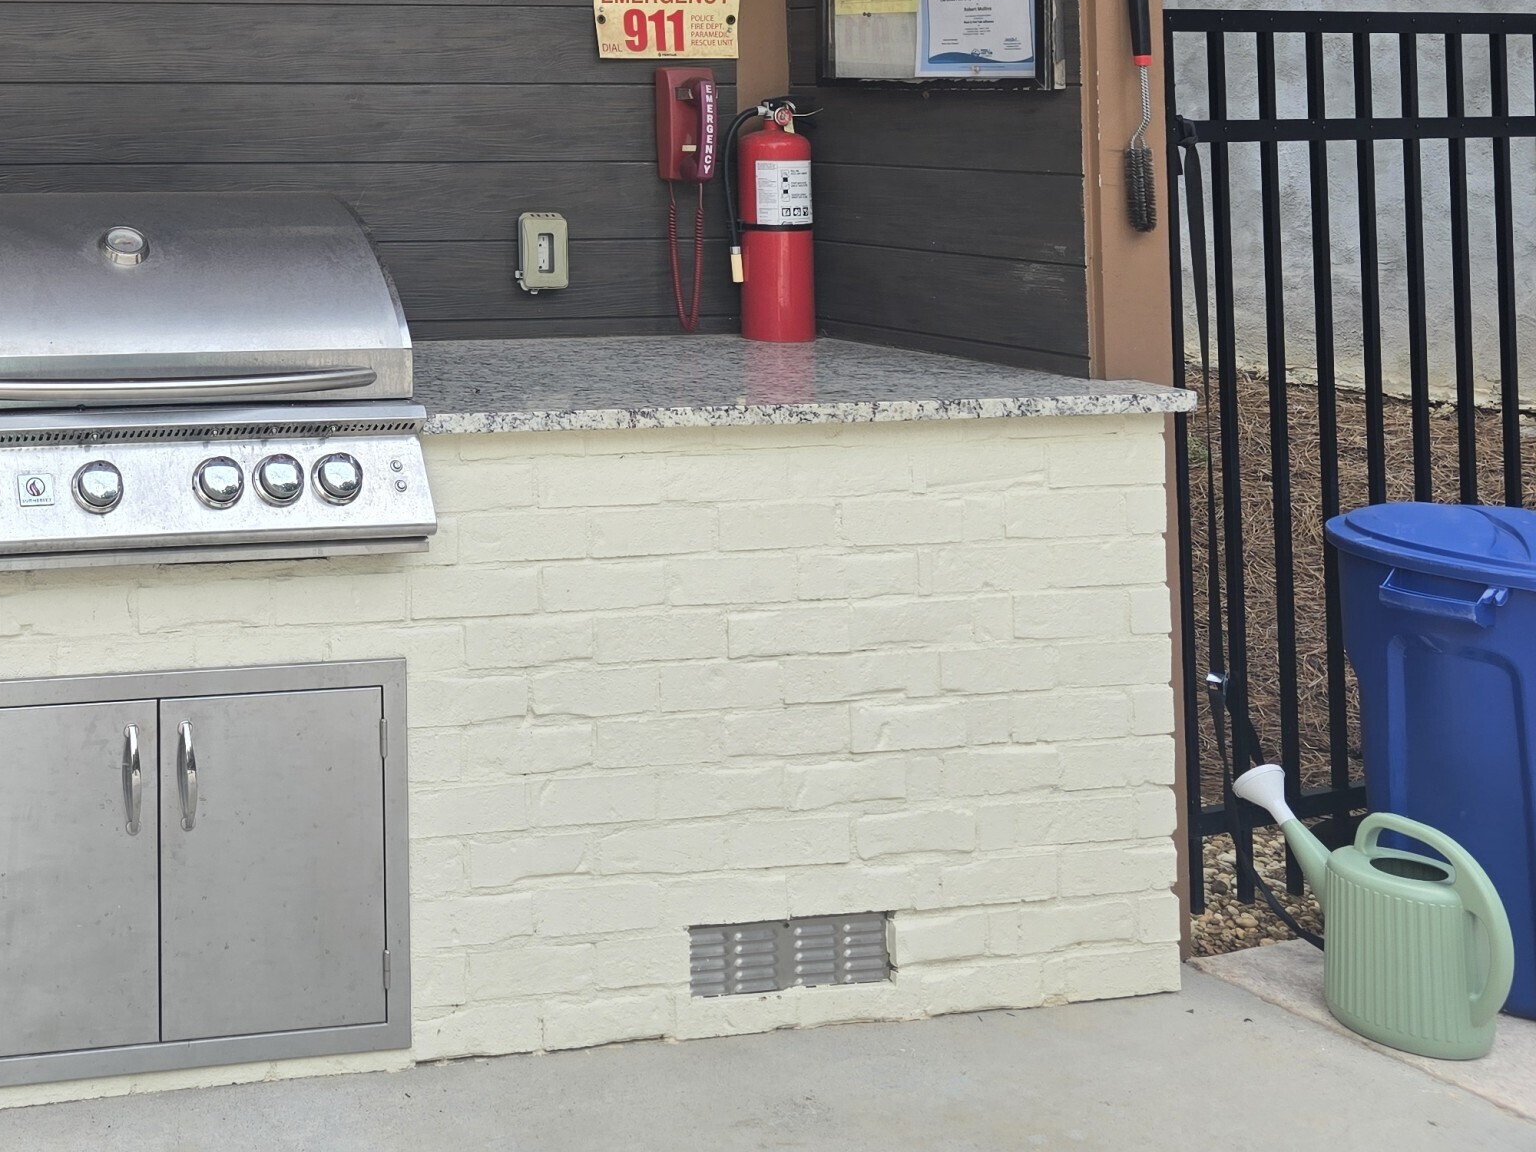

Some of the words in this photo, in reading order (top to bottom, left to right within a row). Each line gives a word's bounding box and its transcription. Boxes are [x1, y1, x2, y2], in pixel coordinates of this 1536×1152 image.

[602, 43, 623, 52] DIAL
[623, 8, 685, 52] 911
[704, 84, 714, 174] EMERGENCY
